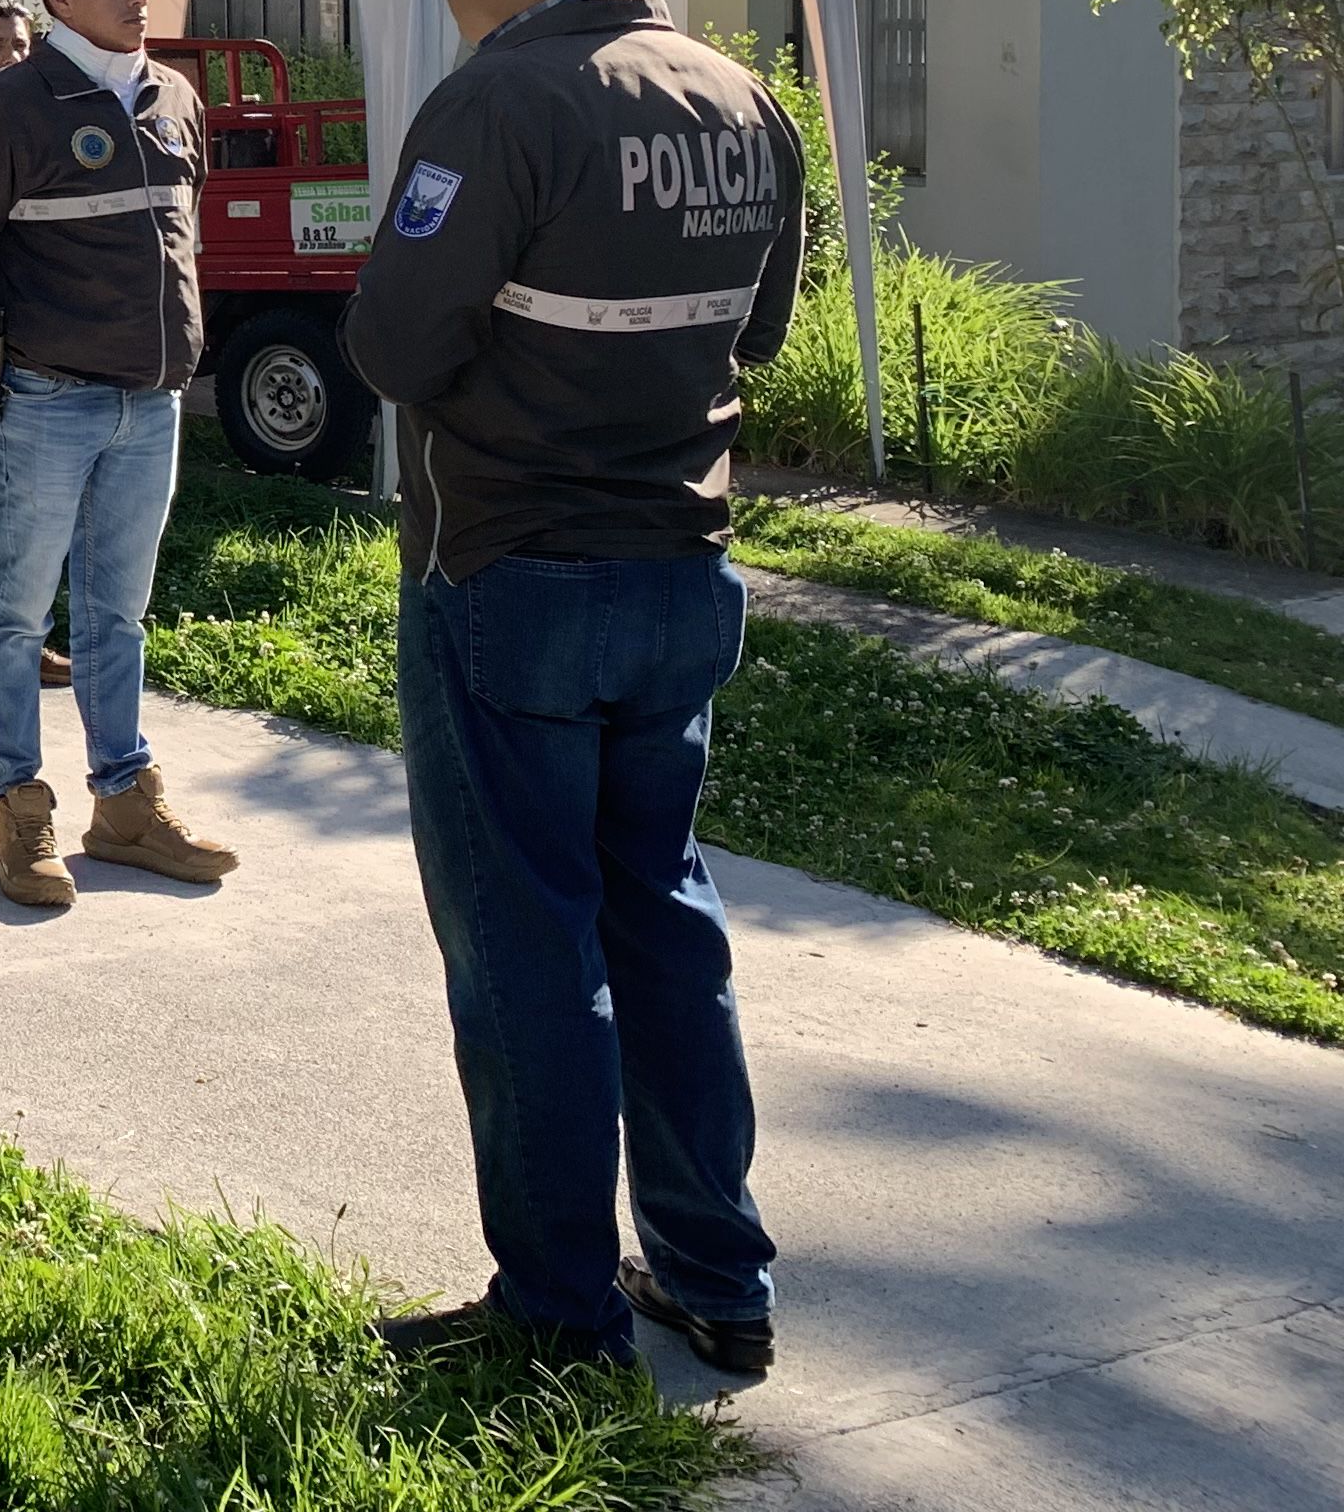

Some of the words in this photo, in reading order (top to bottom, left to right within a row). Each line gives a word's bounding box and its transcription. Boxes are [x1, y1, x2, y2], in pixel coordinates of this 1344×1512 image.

[416, 166, 454, 187] ECUADOR
[682, 204, 776, 239] NACIONAL
[302, 226, 310, 242] 8
[313, 229, 321, 242] a
[323, 226, 338, 242] 12
[500, 287, 534, 305] OLICÍA
